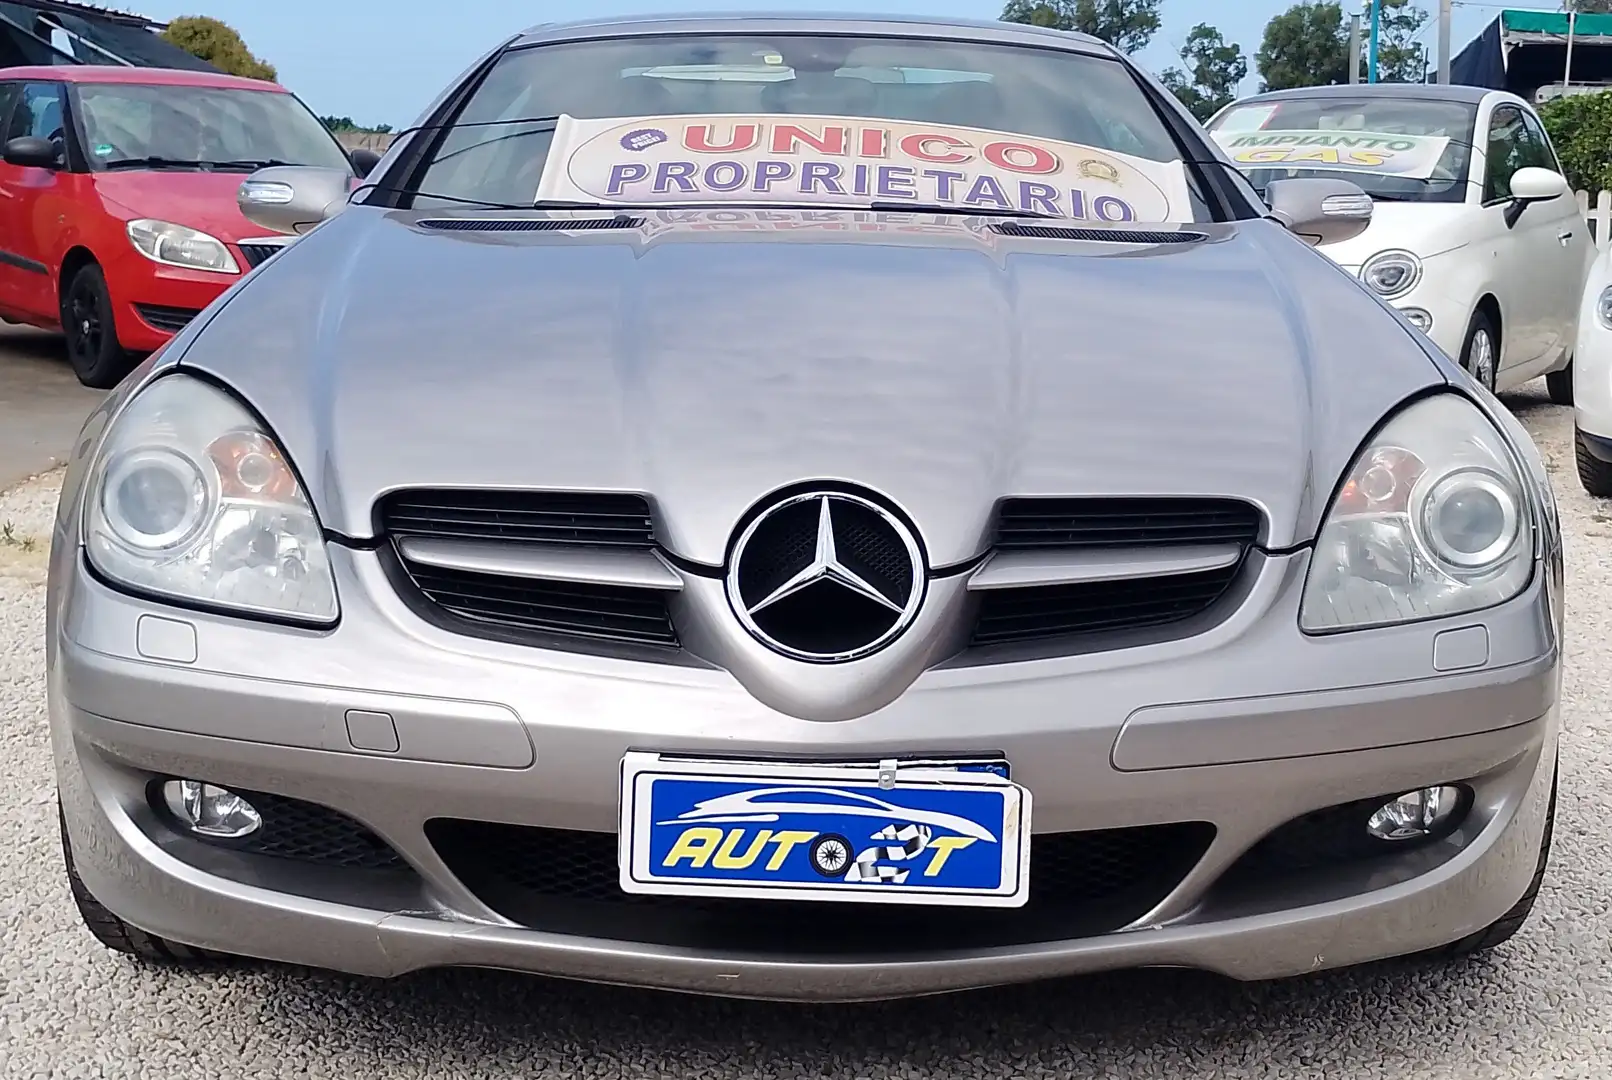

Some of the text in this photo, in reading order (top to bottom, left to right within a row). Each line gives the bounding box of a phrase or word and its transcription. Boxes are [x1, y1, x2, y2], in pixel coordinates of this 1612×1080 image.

[683, 124, 1061, 174] UNICO
[1228, 135, 1416, 151] IMPIANTO
[1233, 147, 1394, 166] GAS
[605, 160, 1136, 222] PROPRIETARIO
